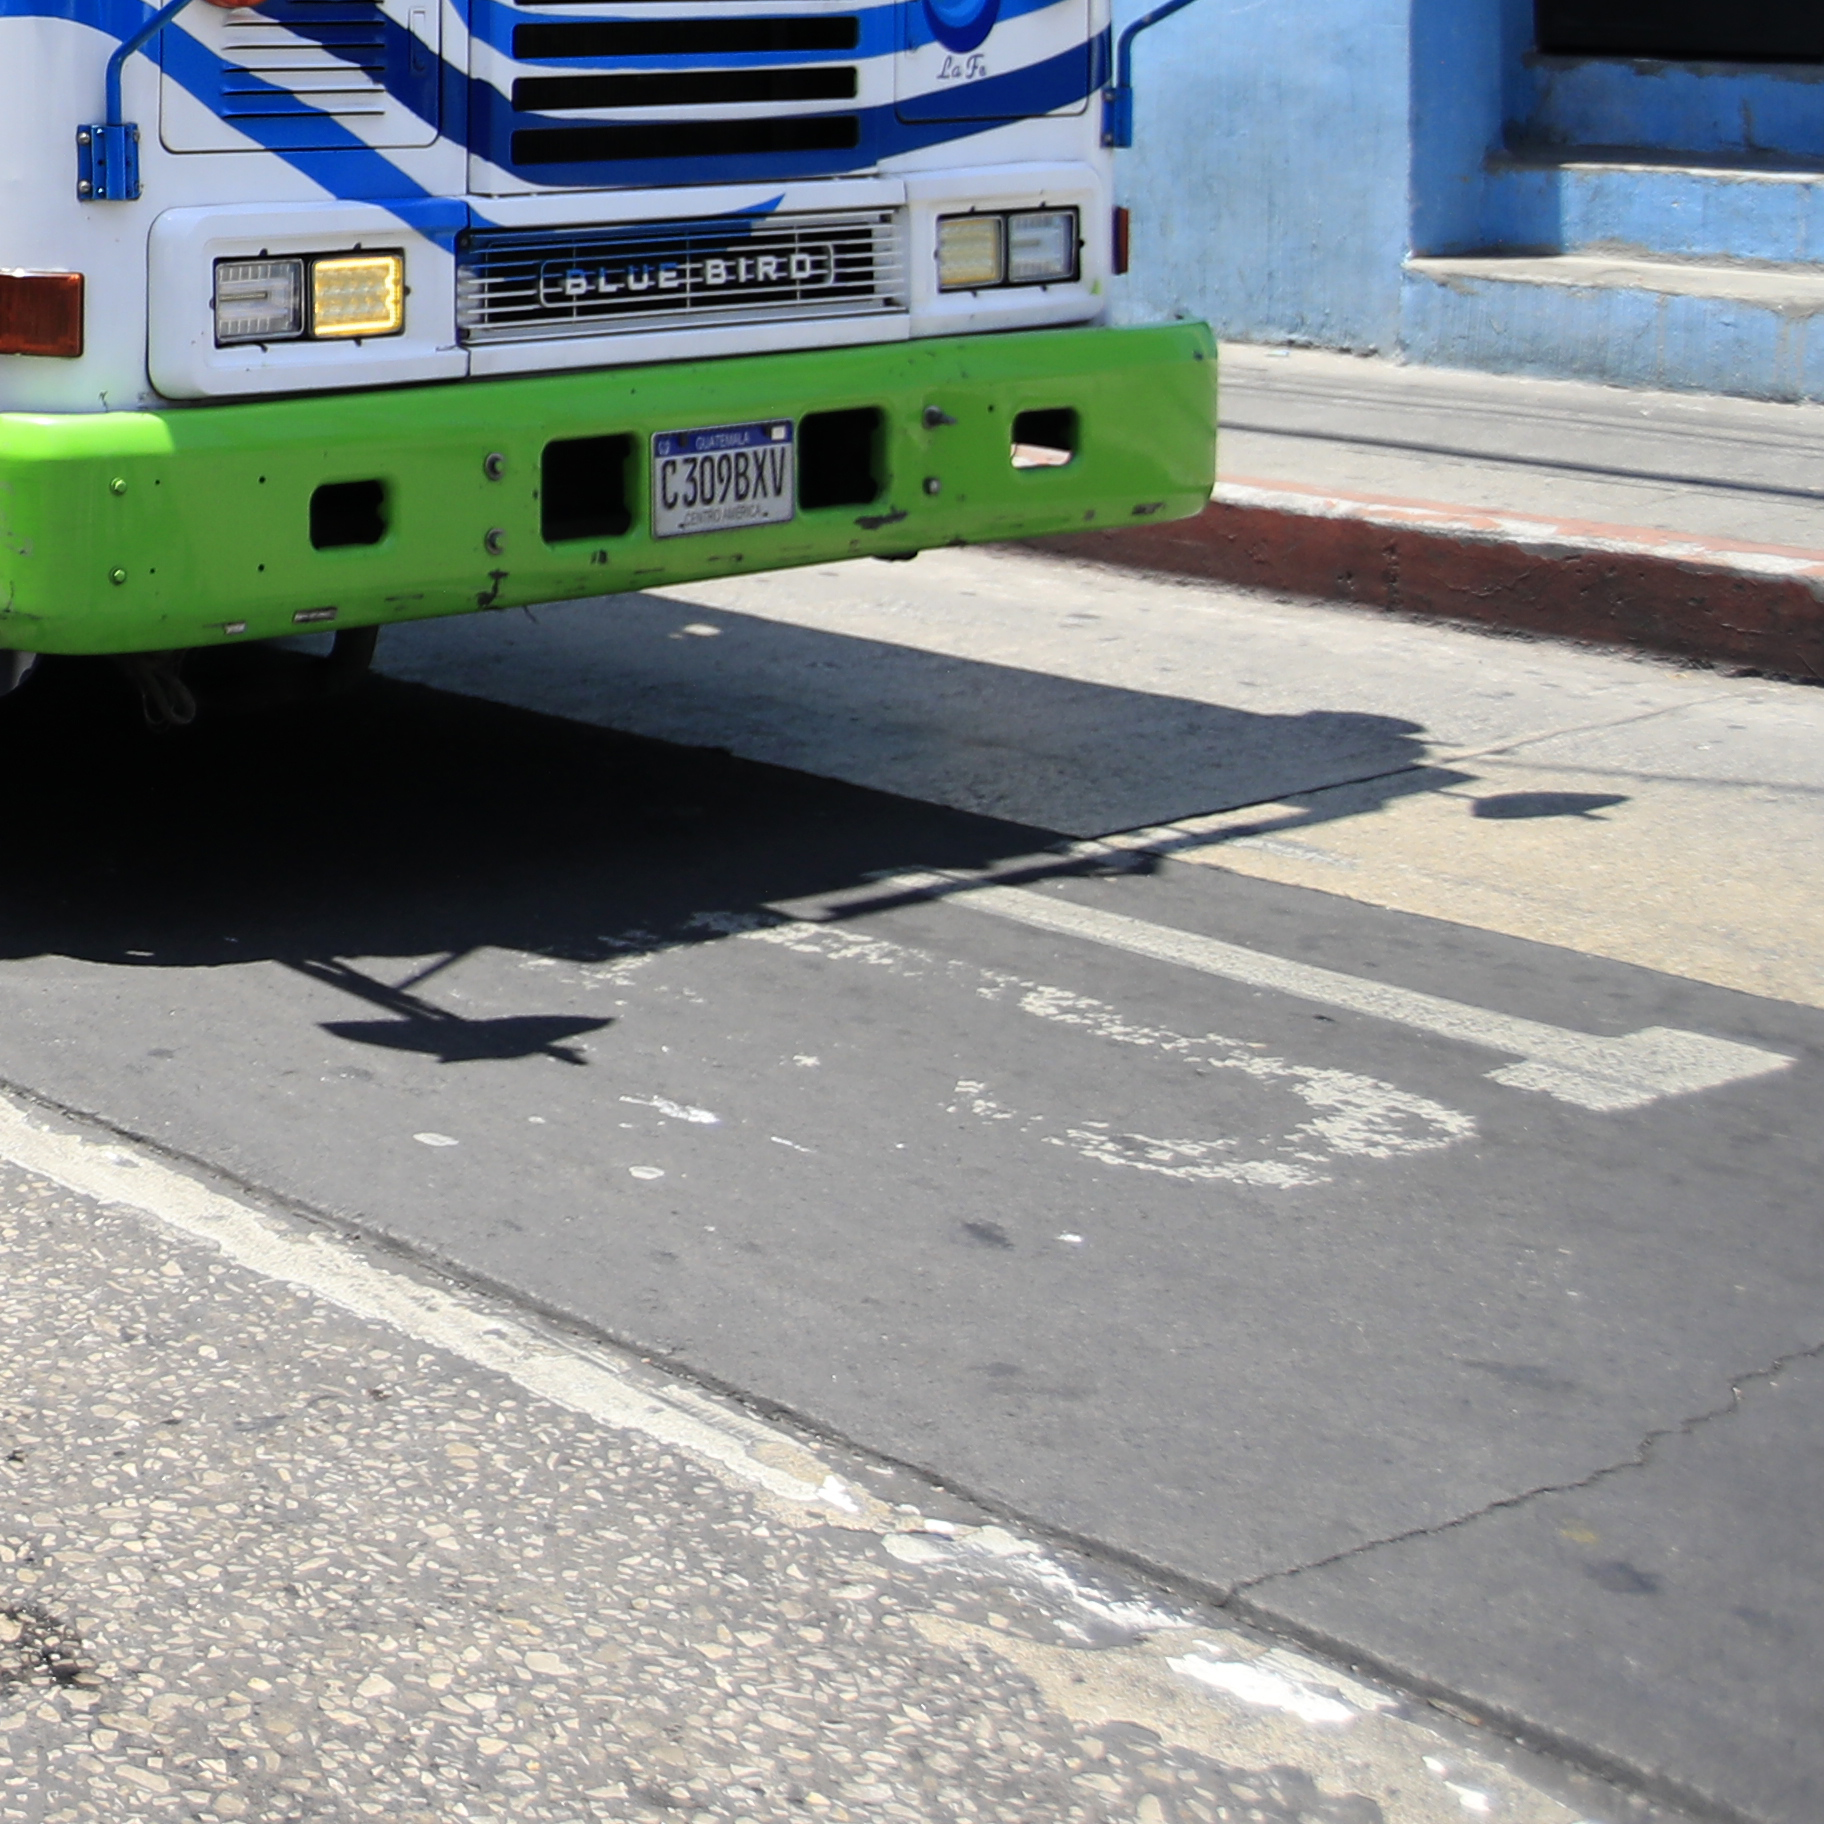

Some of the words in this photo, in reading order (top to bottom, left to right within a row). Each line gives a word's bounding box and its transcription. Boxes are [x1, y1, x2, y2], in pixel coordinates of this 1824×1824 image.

[936, 55, 962, 80] La
[965, 53, 987, 80] Fe
[565, 262, 680, 296] BLUE
[704, 253, 813, 286] BIRD
[695, 431, 750, 451] GUATEMALA
[661, 446, 786, 511] C309BXV
